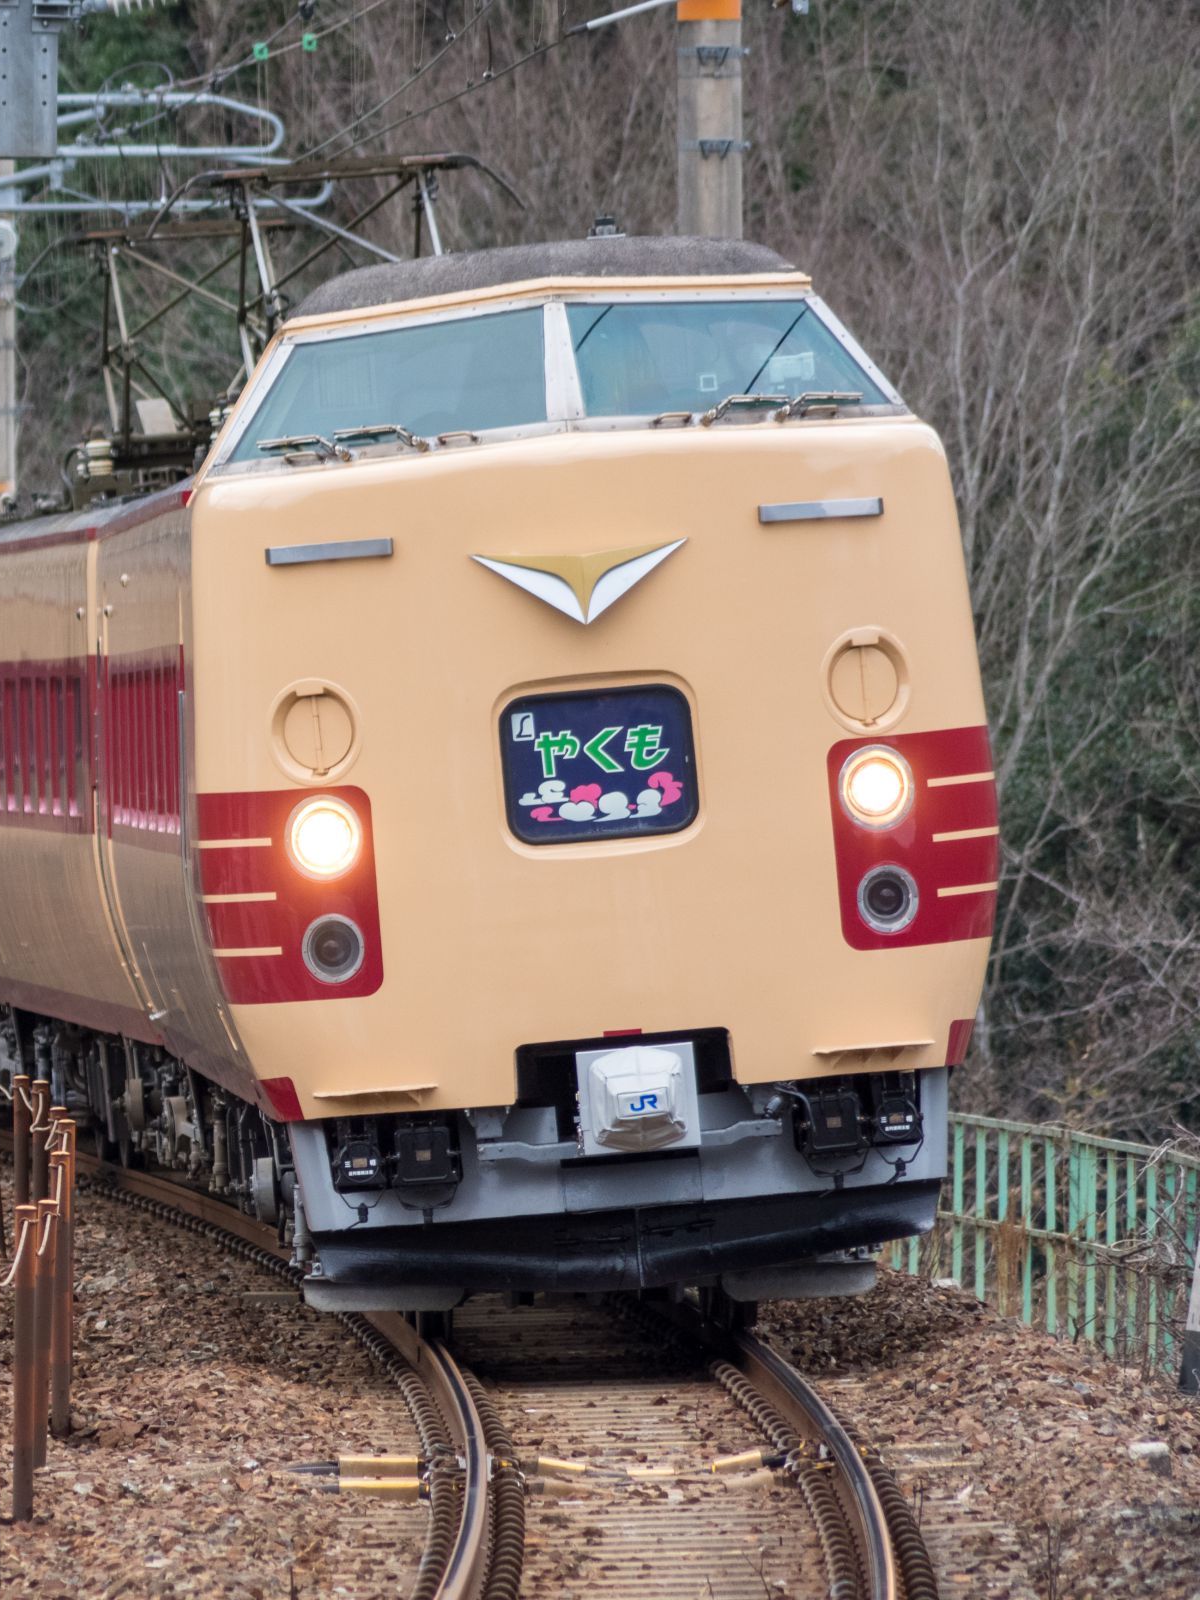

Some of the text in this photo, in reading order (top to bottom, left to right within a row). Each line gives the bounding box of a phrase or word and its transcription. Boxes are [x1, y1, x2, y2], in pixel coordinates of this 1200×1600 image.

[533, 724, 671, 779] やくも
[630, 1094, 658, 1112] JR
